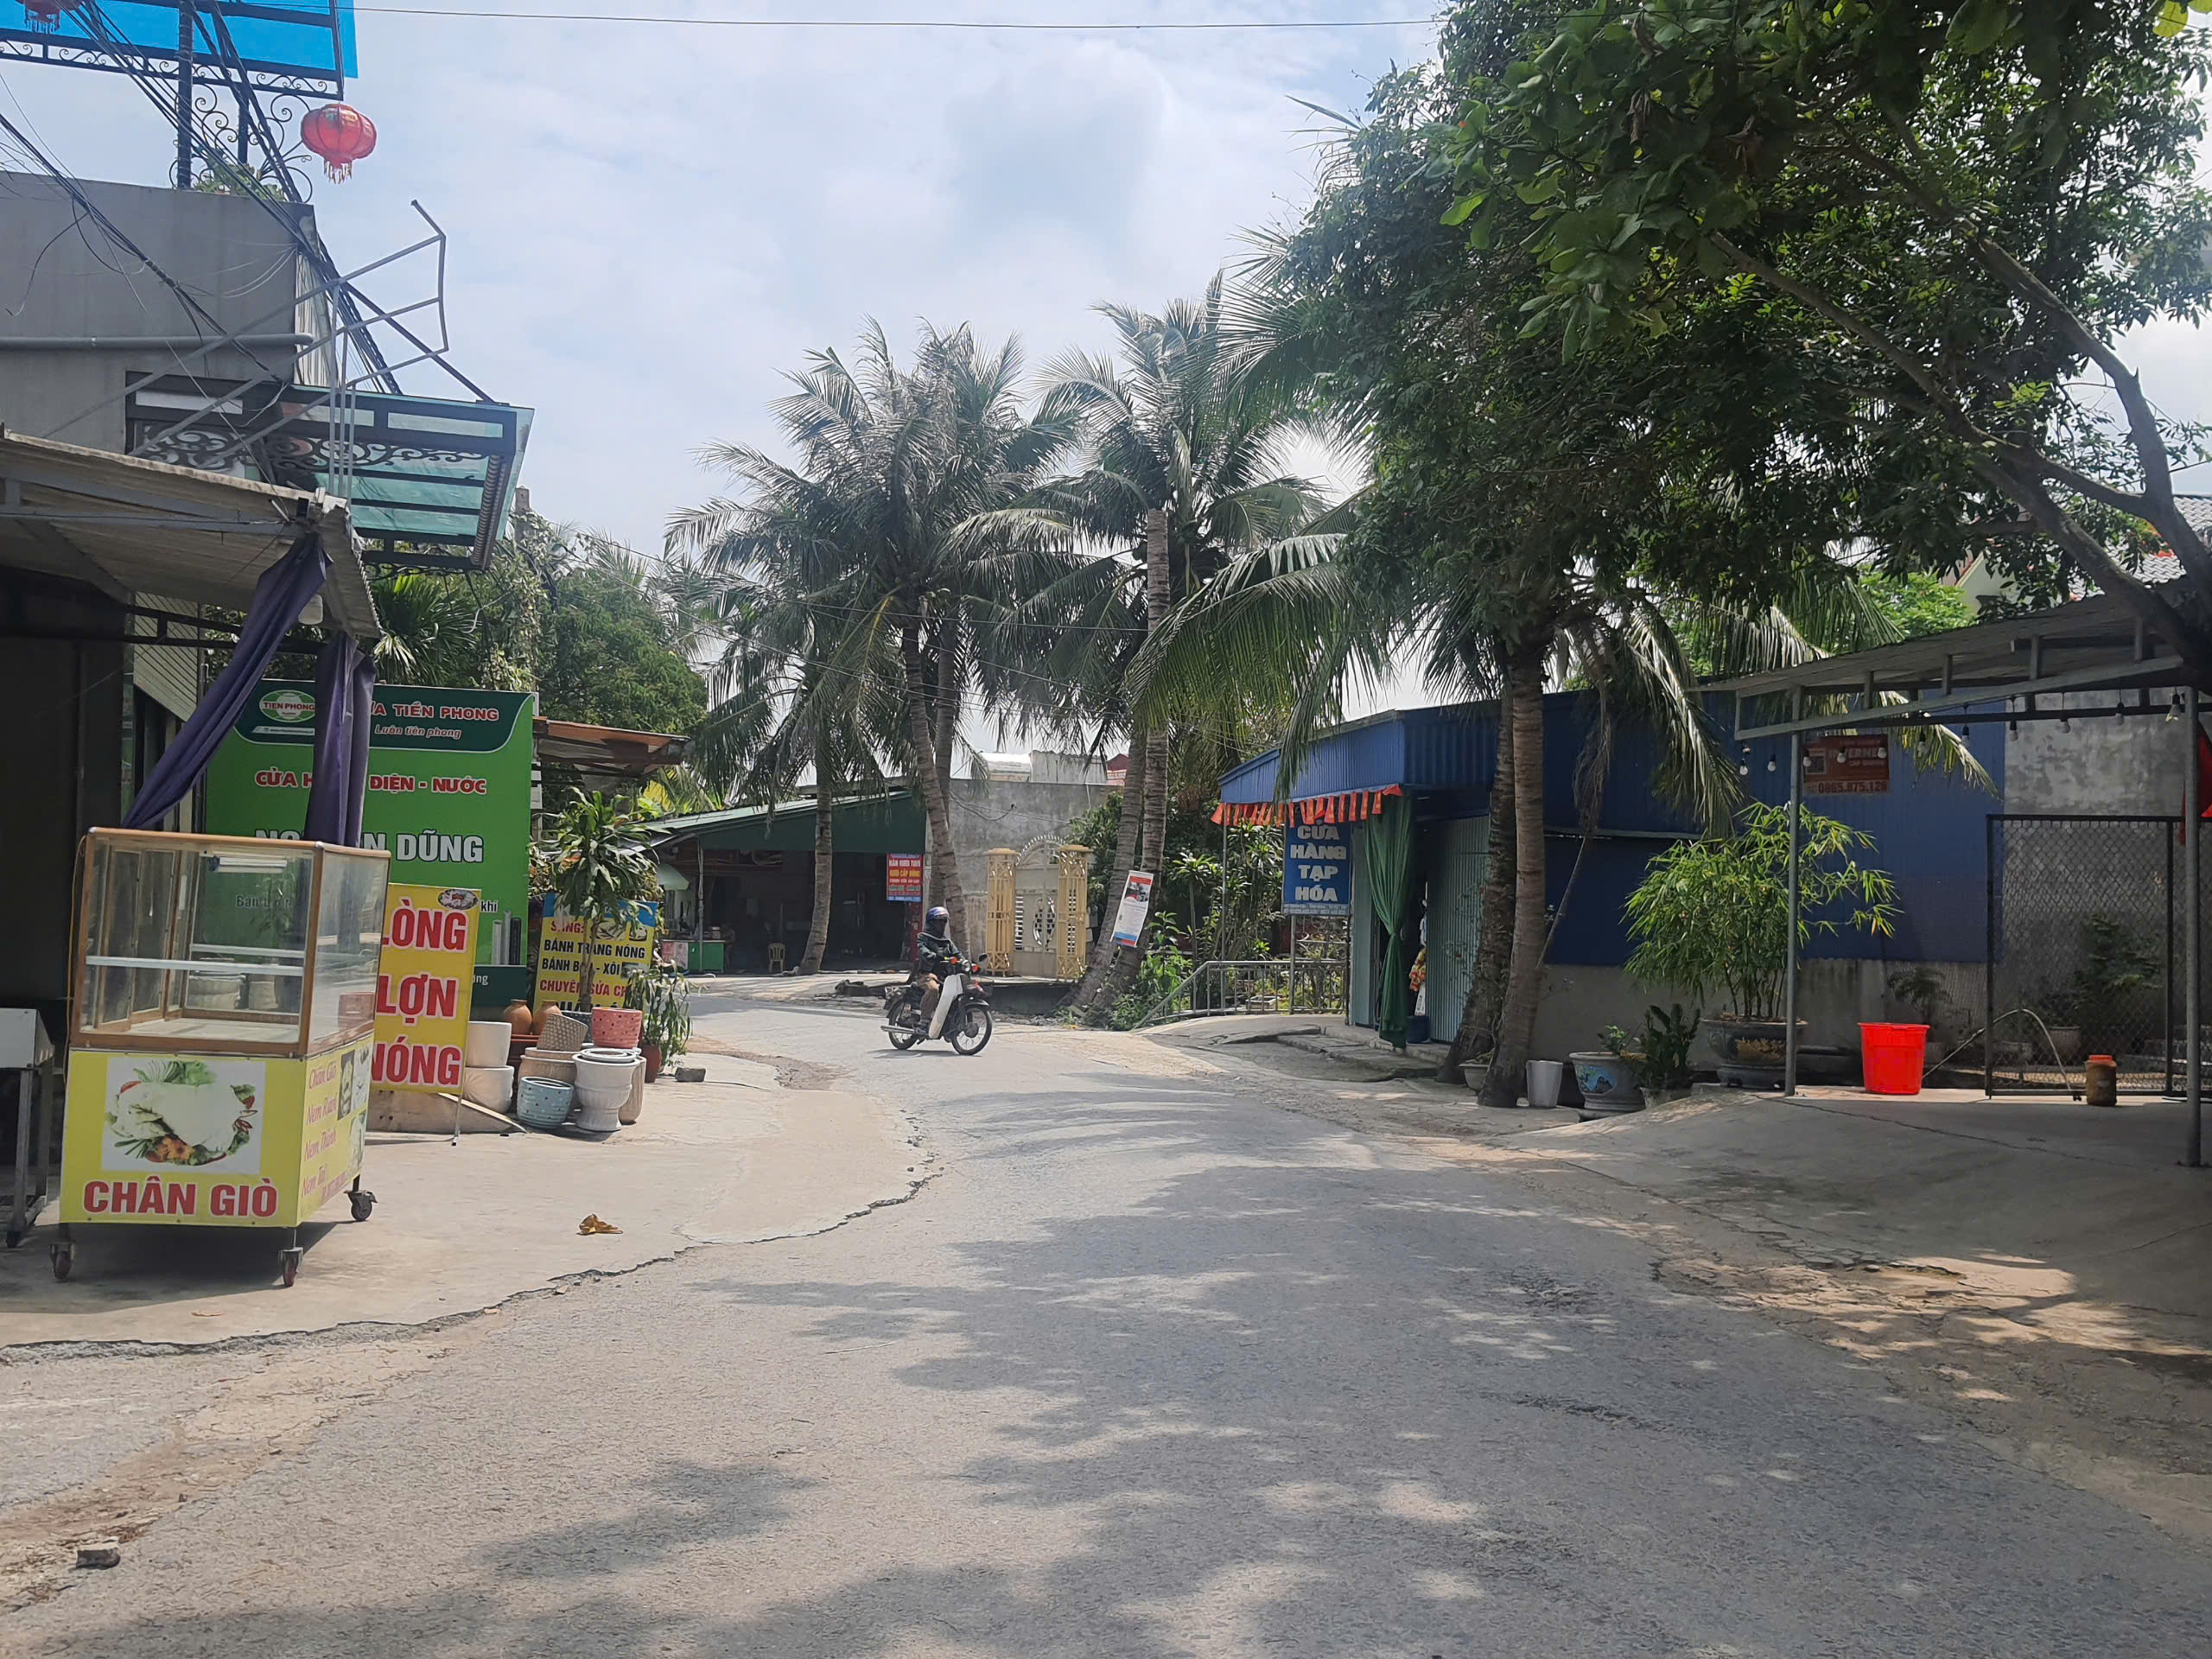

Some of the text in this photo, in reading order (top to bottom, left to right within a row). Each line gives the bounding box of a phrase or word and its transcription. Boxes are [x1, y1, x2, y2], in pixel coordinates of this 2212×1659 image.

[440, 706, 499, 721] PHONG
[375, 724, 403, 734] Luôn
[426, 727, 461, 740] phong
[255, 766, 298, 788] CỬA
[369, 773, 415, 794] ĐIỆN
[432, 775, 486, 794] NƯỚC
[1297, 819, 1340, 840] CỬA
[396, 829, 484, 862] DŨNG
[1290, 842, 1347, 860] HÀNG
[1298, 865, 1338, 881] TẠP
[1295, 884, 1338, 901] HÓA
[381, 899, 467, 950] ÒNG
[544, 938, 574, 953] BÁNH
[615, 944, 645, 958] NÓNG
[542, 957, 570, 972] BÁNH
[602, 961, 620, 976] XÔI
[376, 973, 459, 1027] LỢN
[83, 1176, 197, 1216] CHÂN
[210, 1177, 277, 1217] GIÒ
